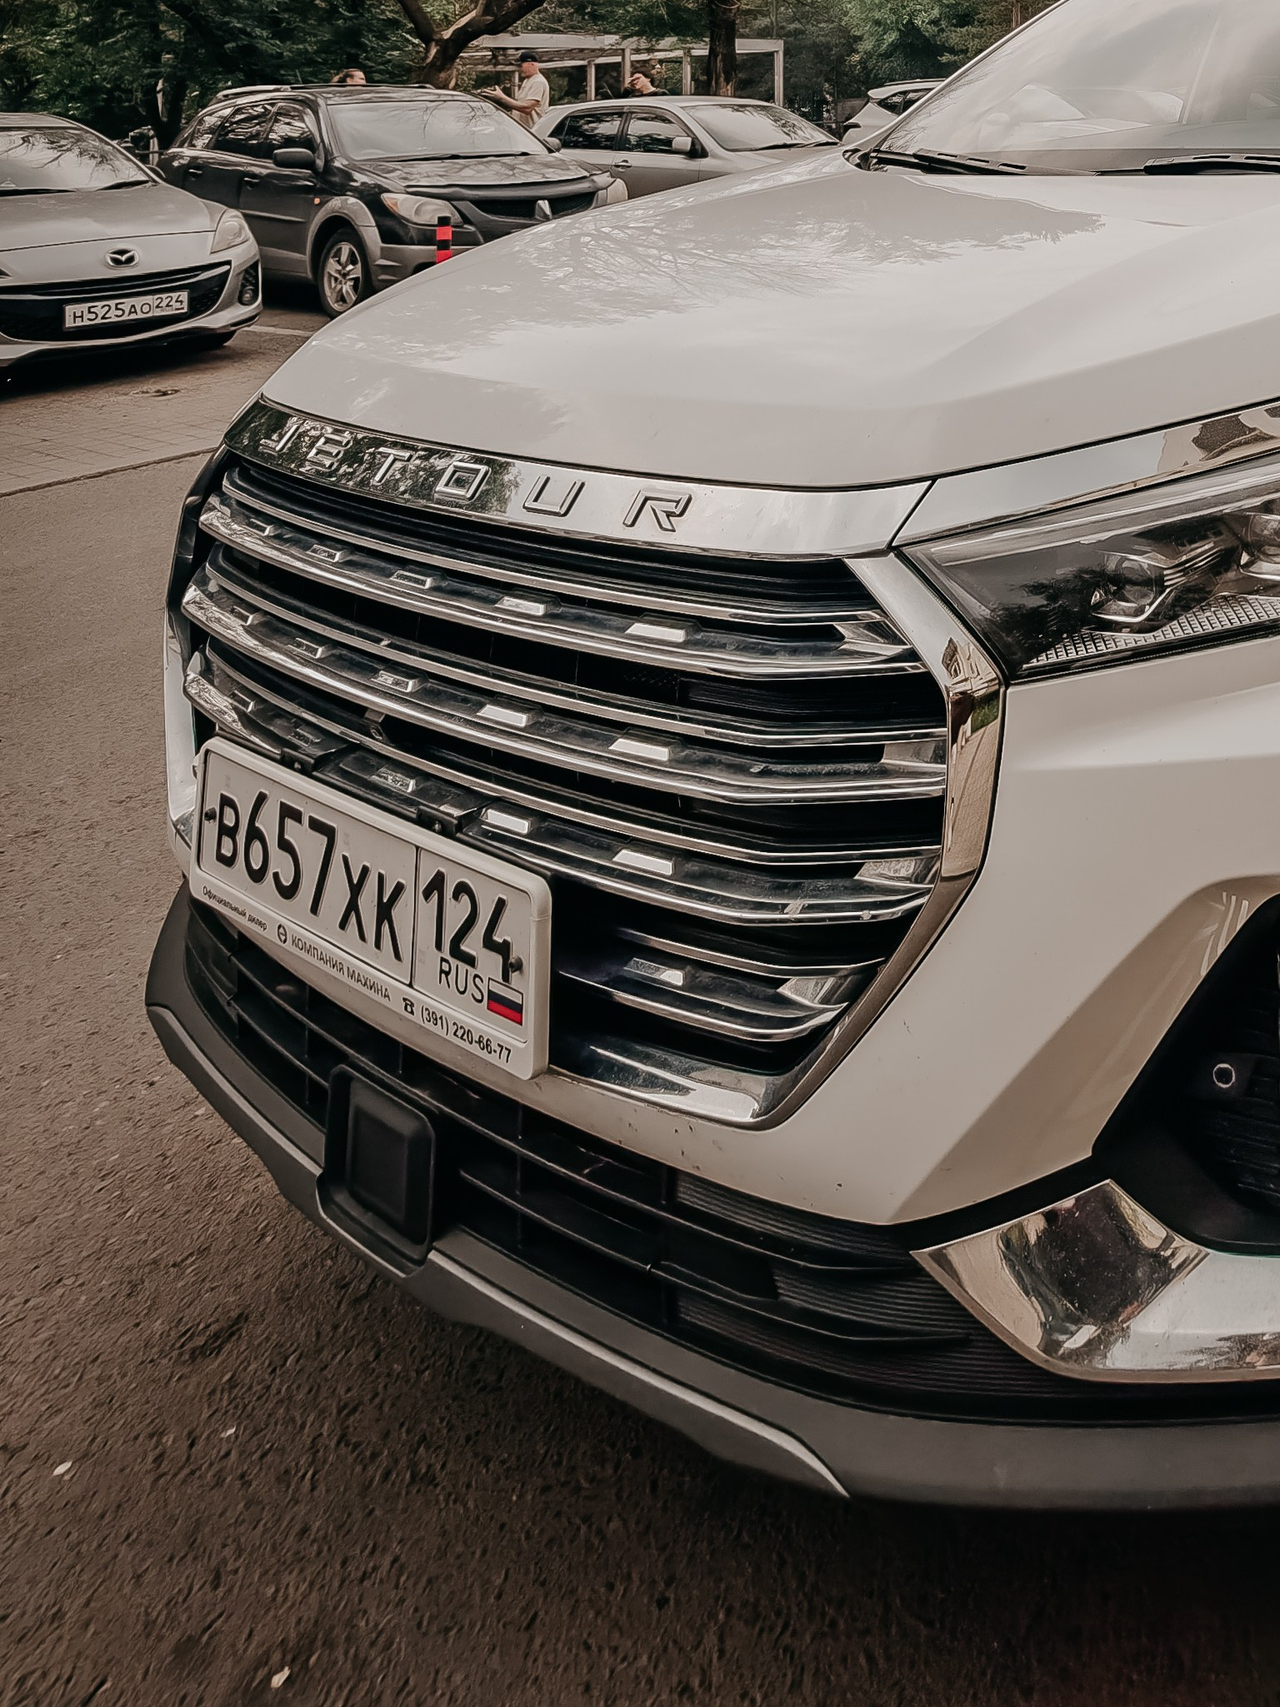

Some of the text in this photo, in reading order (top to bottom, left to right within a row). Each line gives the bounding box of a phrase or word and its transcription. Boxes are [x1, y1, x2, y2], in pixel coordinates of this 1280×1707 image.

[154, 294, 184, 309] 224
[259, 422, 693, 533] JETOUR
[421, 868, 512, 983] 124
[291, 934, 391, 1002] КОМПАНИЯ МАХИНА
[438, 956, 485, 1004] RUS
[421, 1005, 512, 1064] (391) 220-66-77
